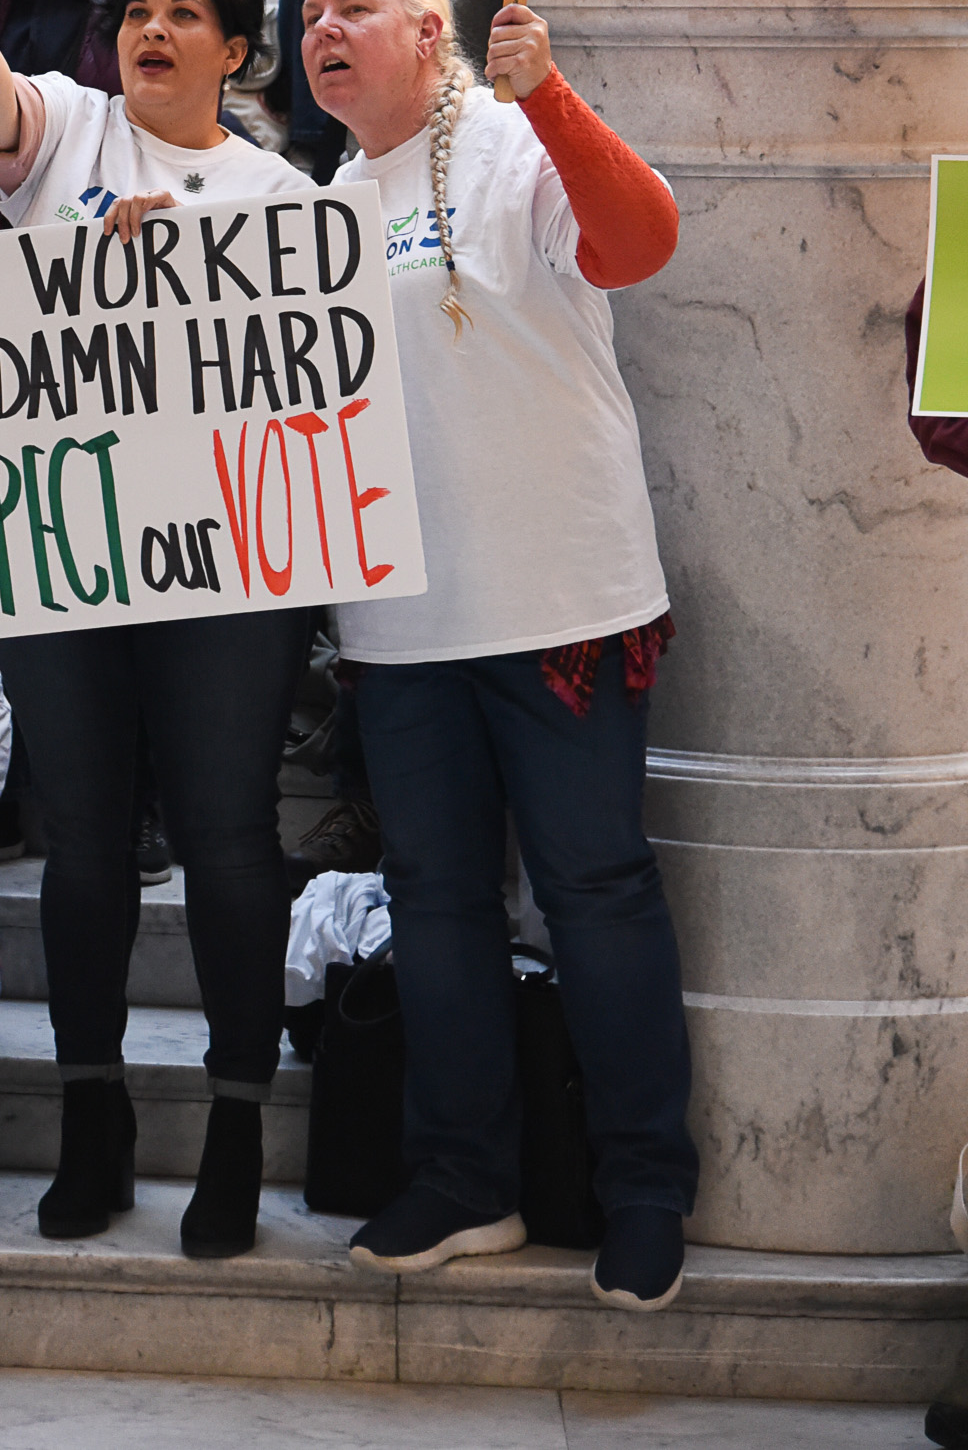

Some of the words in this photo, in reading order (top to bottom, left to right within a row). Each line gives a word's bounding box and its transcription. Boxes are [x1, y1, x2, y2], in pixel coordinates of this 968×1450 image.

[58, 204, 84, 221] UTA
[419, 208, 456, 247] 3
[18, 198, 362, 317] WORKED
[386, 237, 413, 260] ON
[388, 257, 446, 277] LTHCARE
[185, 306, 376, 415] HARD
[139, 517, 221, 594] our
[213, 397, 396, 600] VOTE
